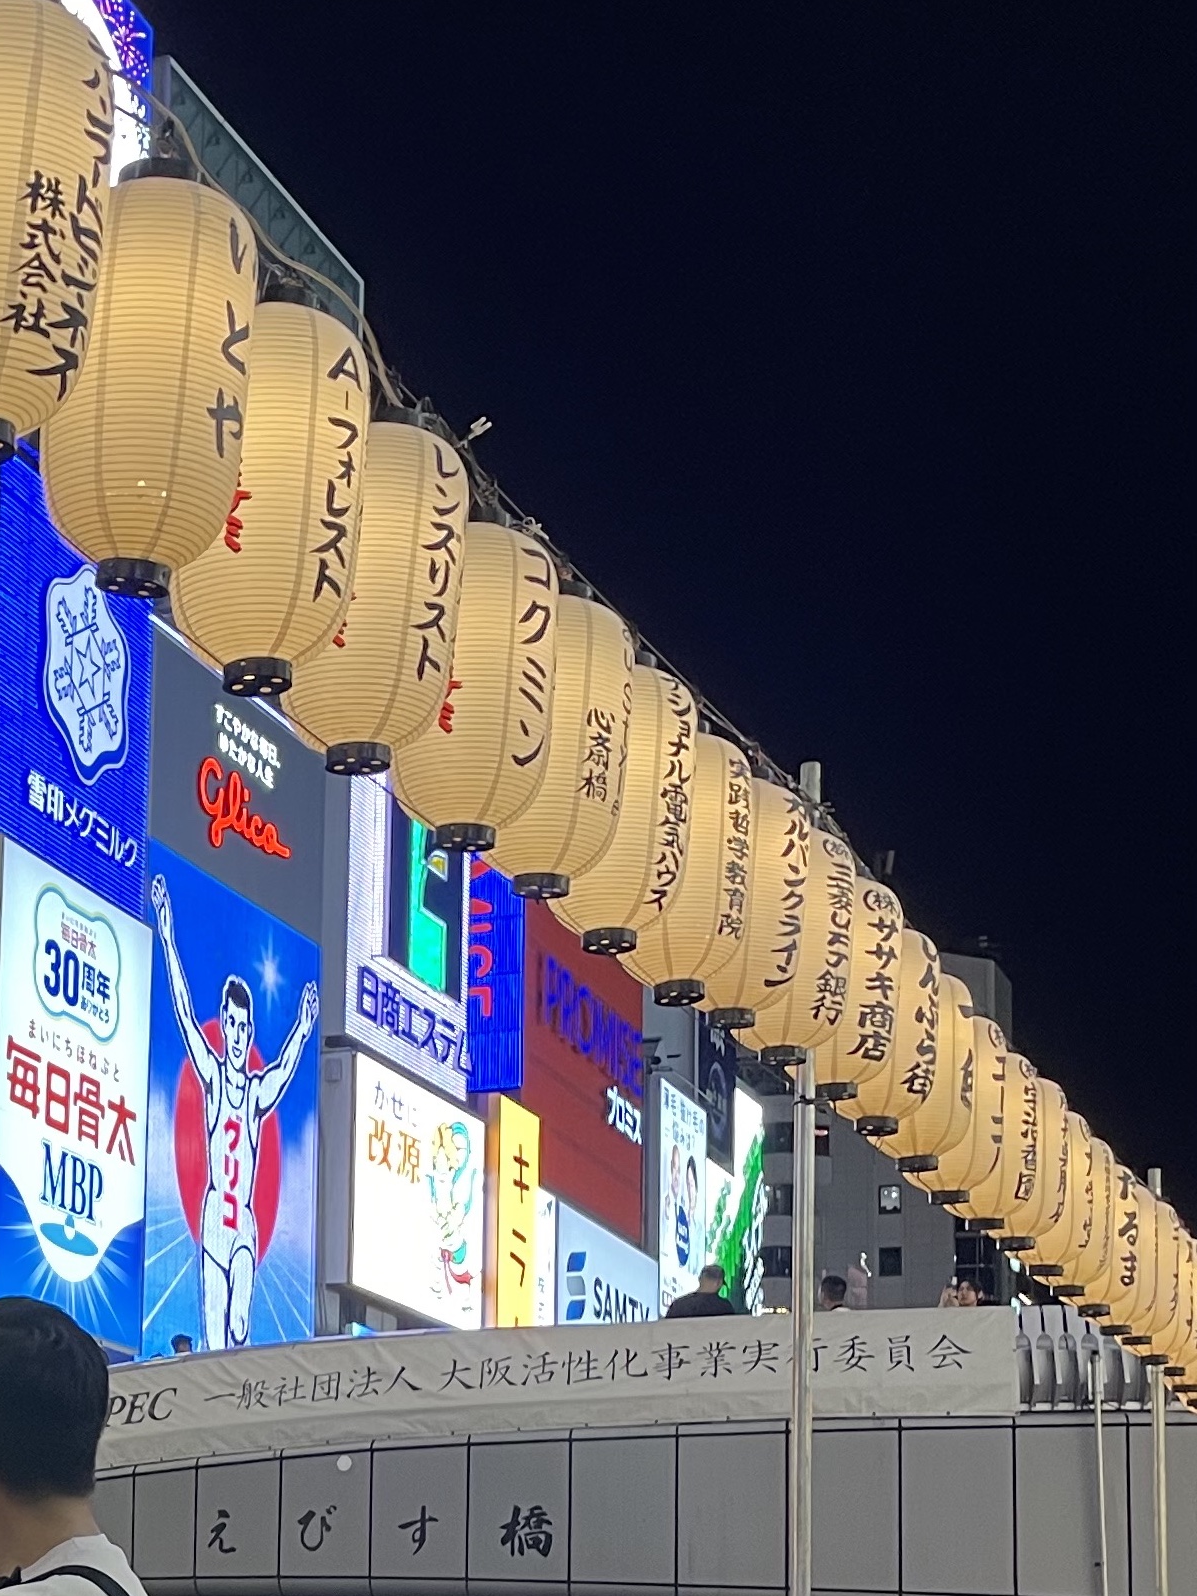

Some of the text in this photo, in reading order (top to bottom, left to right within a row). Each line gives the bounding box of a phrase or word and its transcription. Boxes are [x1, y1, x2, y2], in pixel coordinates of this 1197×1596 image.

[510, 546, 556, 768] コクミン
[575, 706, 616, 803] 心斎橋
[27, 769, 138, 868] 雪印メグミルク
[197, 756, 292, 859] Glico
[43, 938, 111, 1007] 30周年
[356, 965, 475, 1078] 日商エステム
[6, 1035, 137, 1167] 毎日骨太
[367, 1115, 422, 1184] 改源
[40, 1138, 104, 1223] MBP
[222, 1115, 243, 1231] グリコ
[508, 1143, 531, 1328] キラ
[203, 1364, 422, 1411] 一般社団法人
[440, 1332, 973, 1391] 大阪活性化事業実行委員会
[206, 1503, 554, 1559] えびす橋
